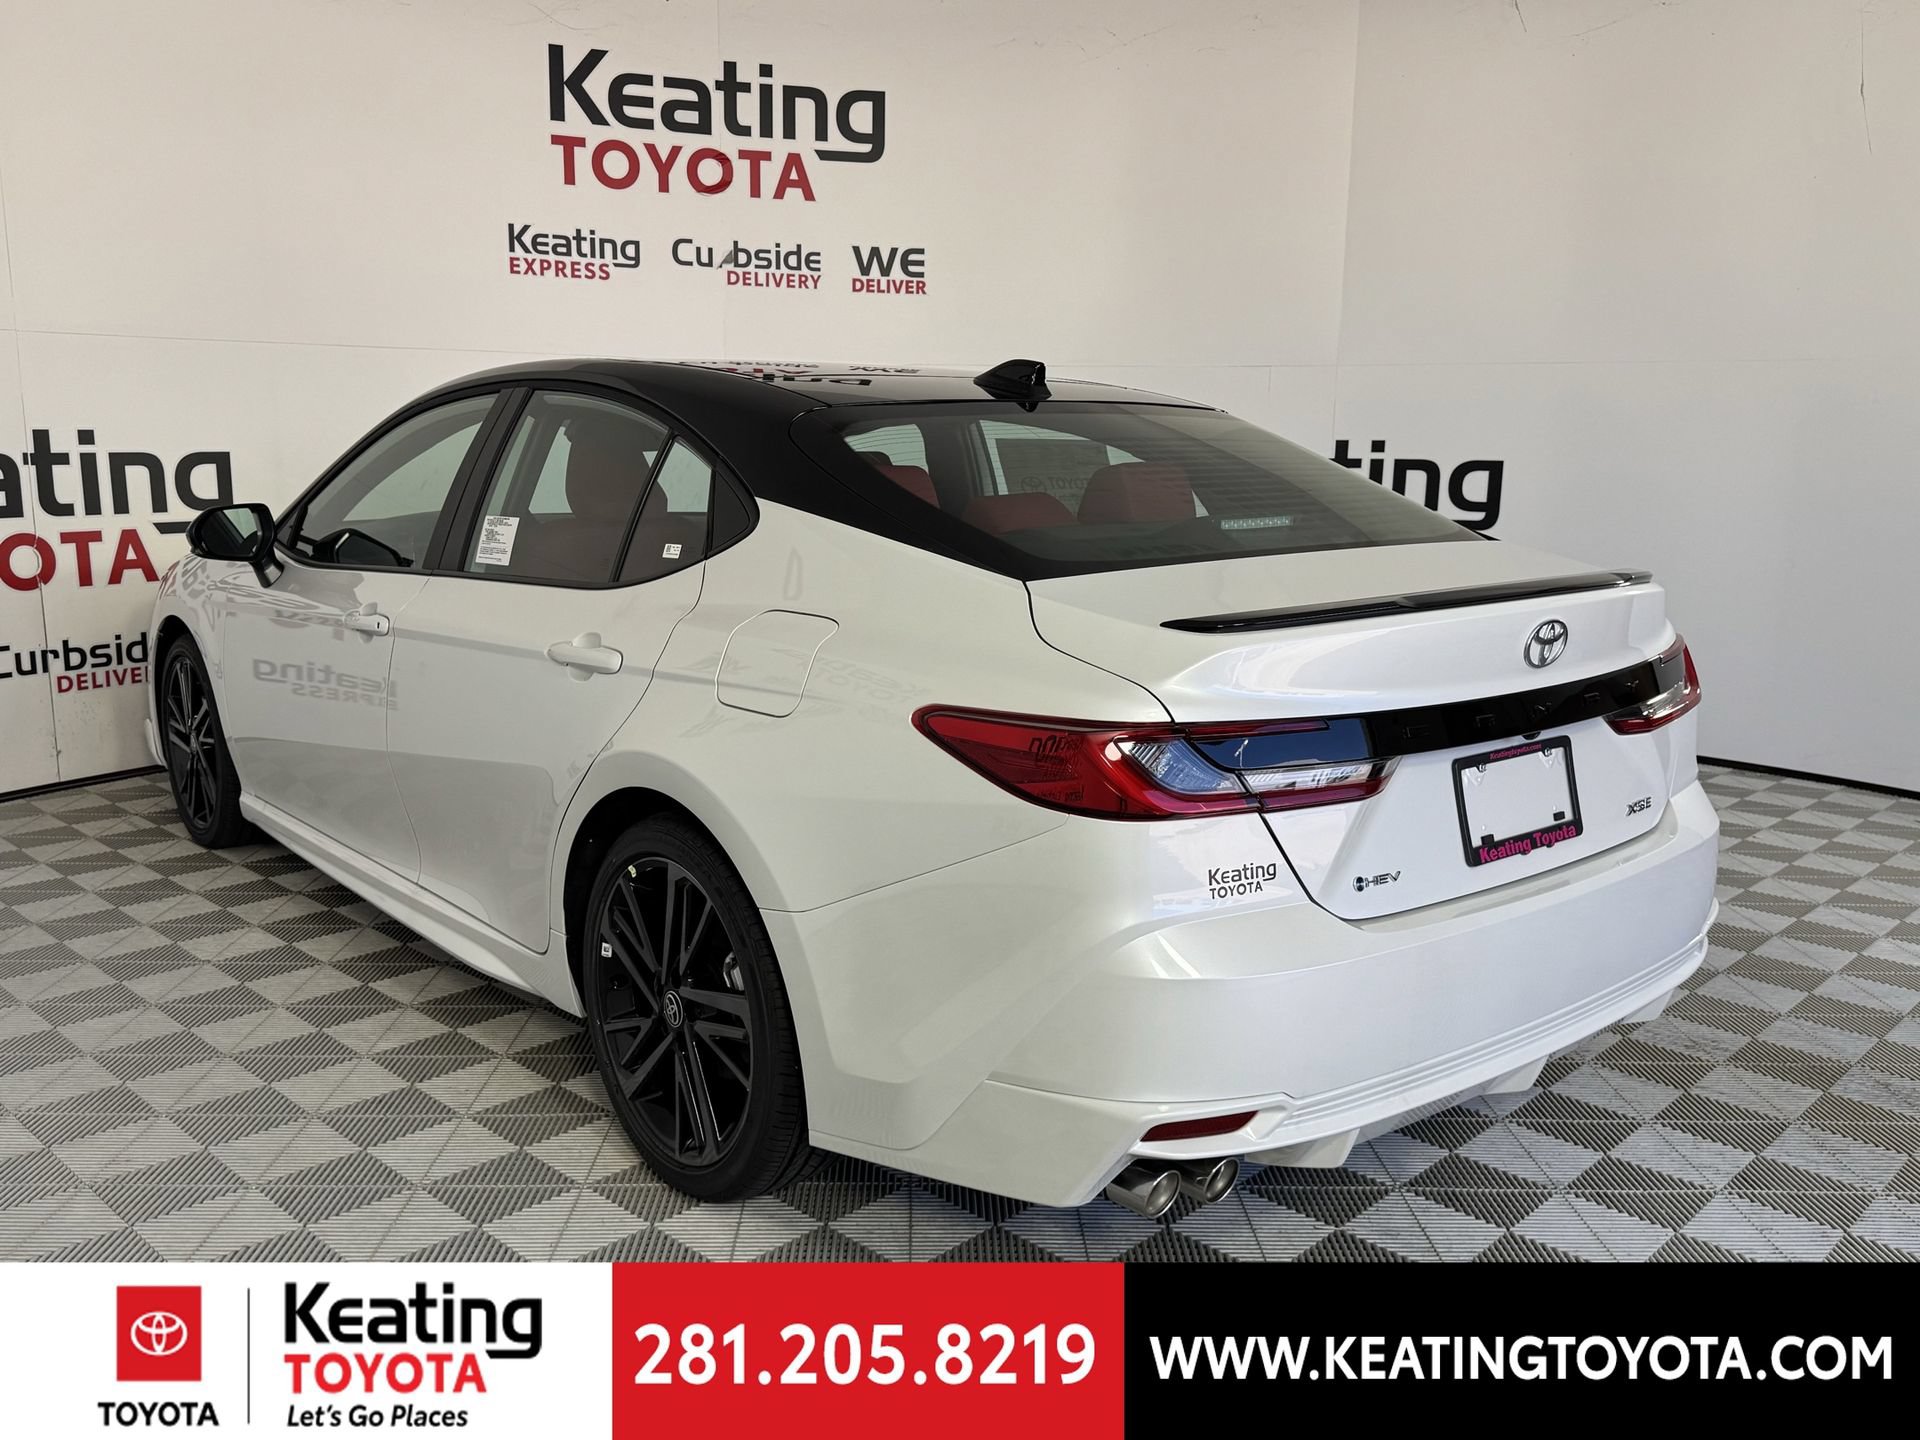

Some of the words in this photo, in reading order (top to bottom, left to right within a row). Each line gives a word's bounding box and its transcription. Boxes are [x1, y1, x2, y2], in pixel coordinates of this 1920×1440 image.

[548, 43, 886, 163] Keating
[550, 134, 816, 202] TOYOTA
[508, 223, 640, 269] Keating
[672, 238, 821, 272] Cubside
[509, 256, 611, 281] EXPRESS
[852, 245, 925, 278] WE
[726, 270, 821, 289] DELIVERY
[852, 278, 927, 295] DELIVER
[56, 666, 149, 694] DELIVE
[1626, 796, 1652, 817] XSE
[1479, 839, 1532, 864] Keating
[1534, 825, 1577, 849] Toyota
[1208, 863, 1277, 886] Keating
[1209, 880, 1263, 899] TOYOTA
